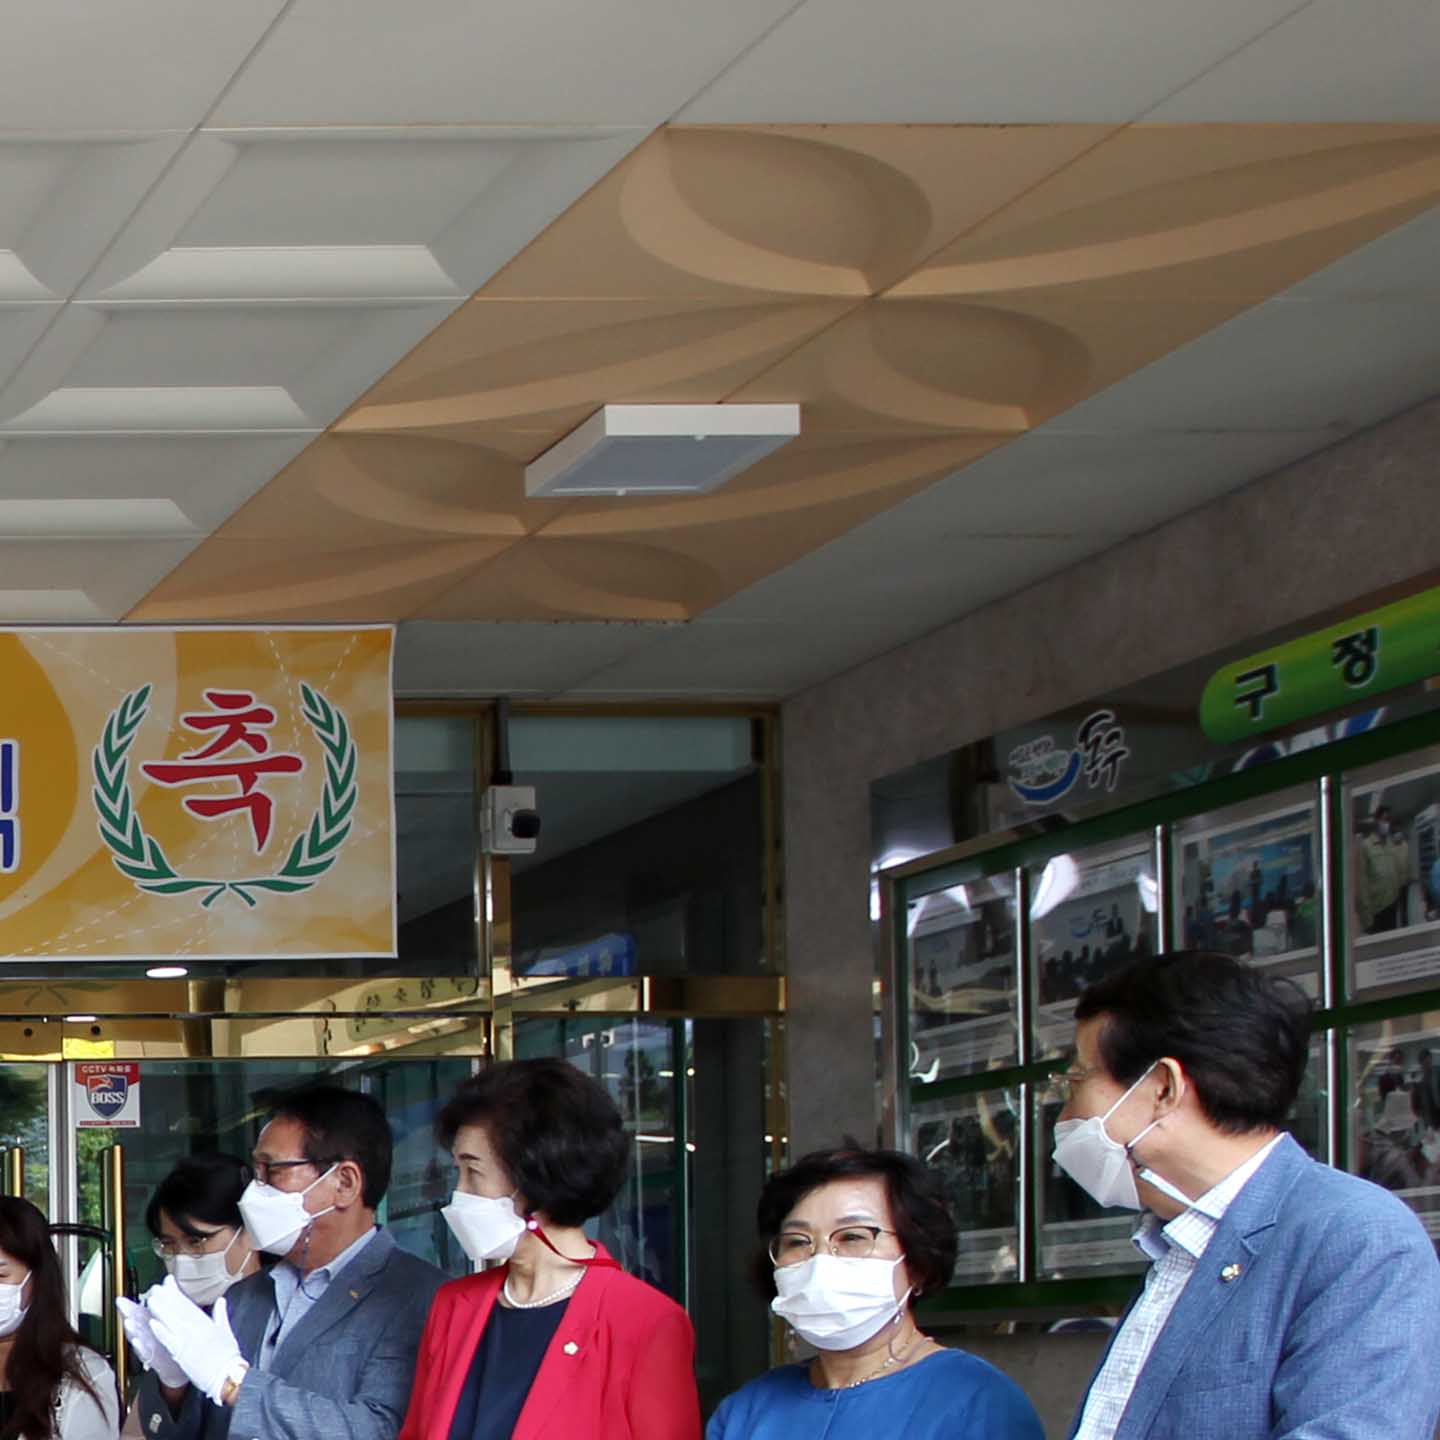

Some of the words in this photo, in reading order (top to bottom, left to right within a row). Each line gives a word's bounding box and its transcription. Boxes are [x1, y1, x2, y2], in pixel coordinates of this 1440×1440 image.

[144, 690, 302, 852] 축
[81, 1064, 108, 1073] CCTV
[91, 1091, 126, 1105] BOSS
